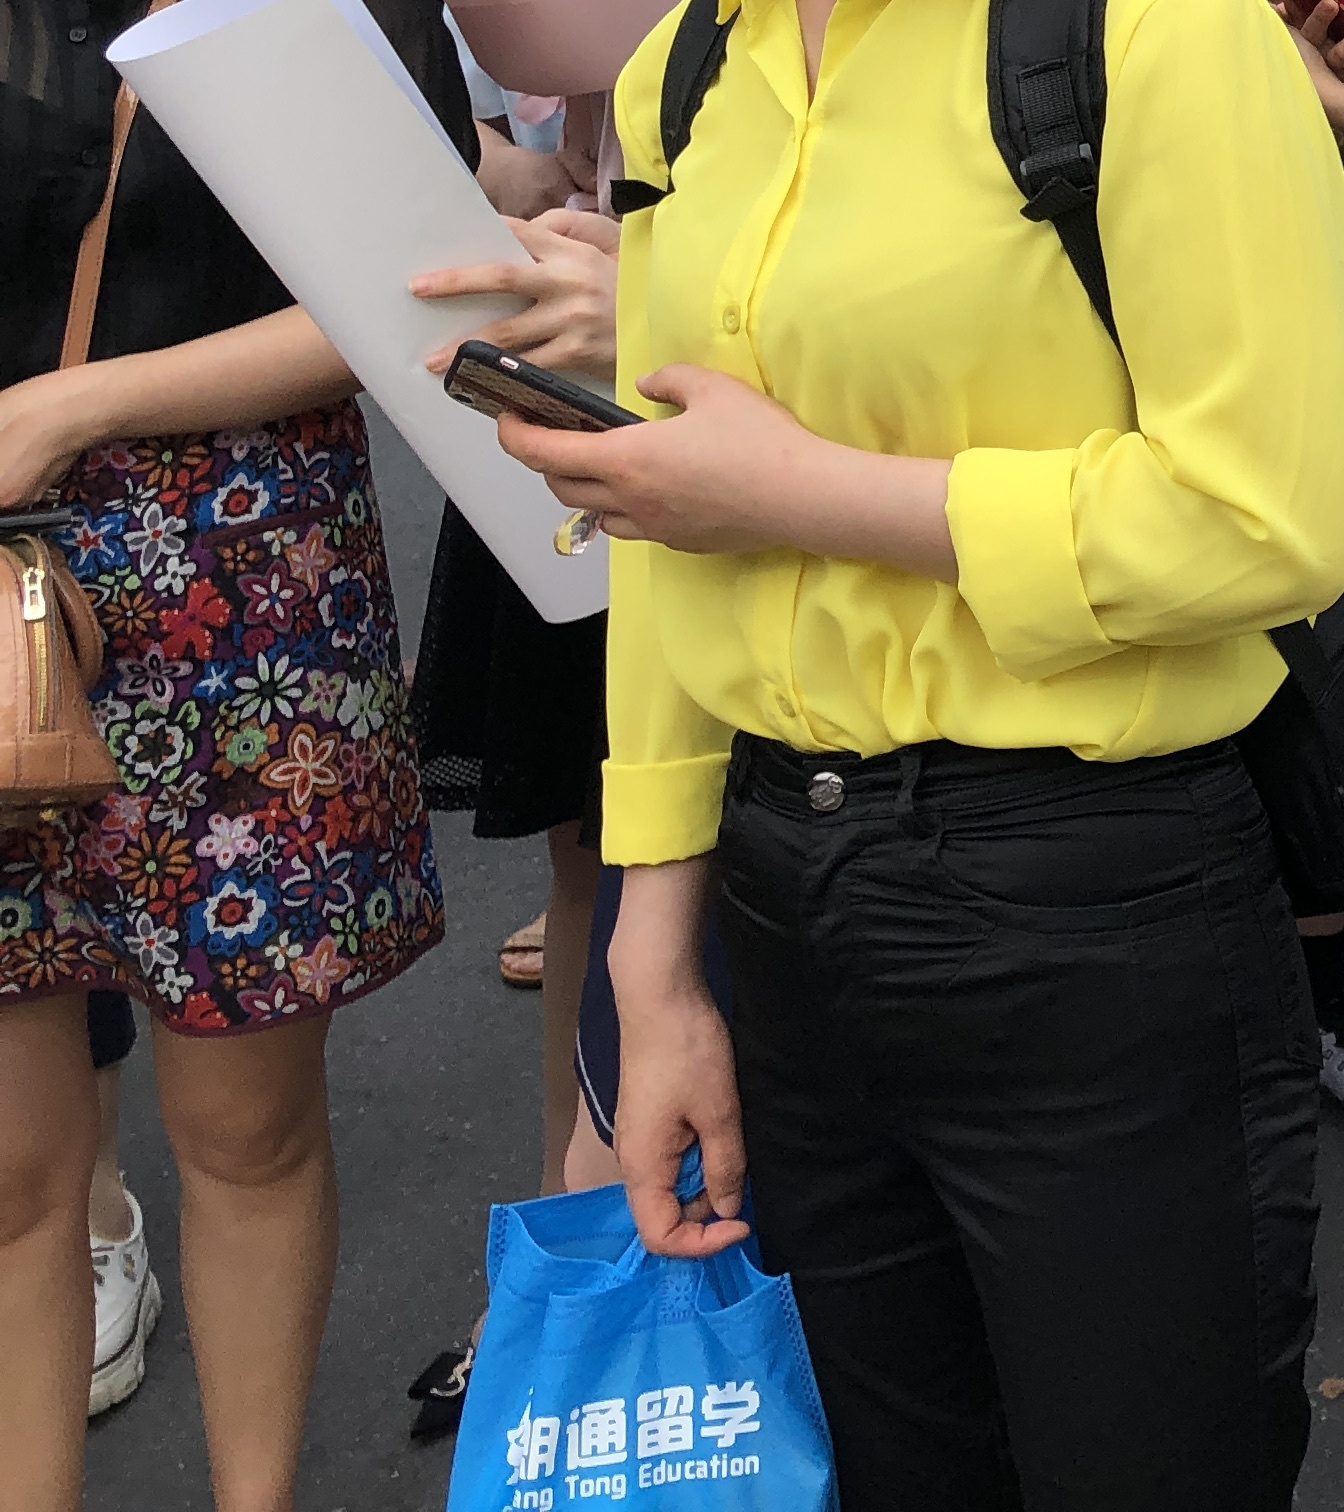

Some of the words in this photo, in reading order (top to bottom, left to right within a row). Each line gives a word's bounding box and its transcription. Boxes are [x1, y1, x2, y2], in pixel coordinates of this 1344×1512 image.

[502, 1485, 555, 1512] ang
[564, 1472, 628, 1501] Tong
[637, 1452, 761, 1489] Education
